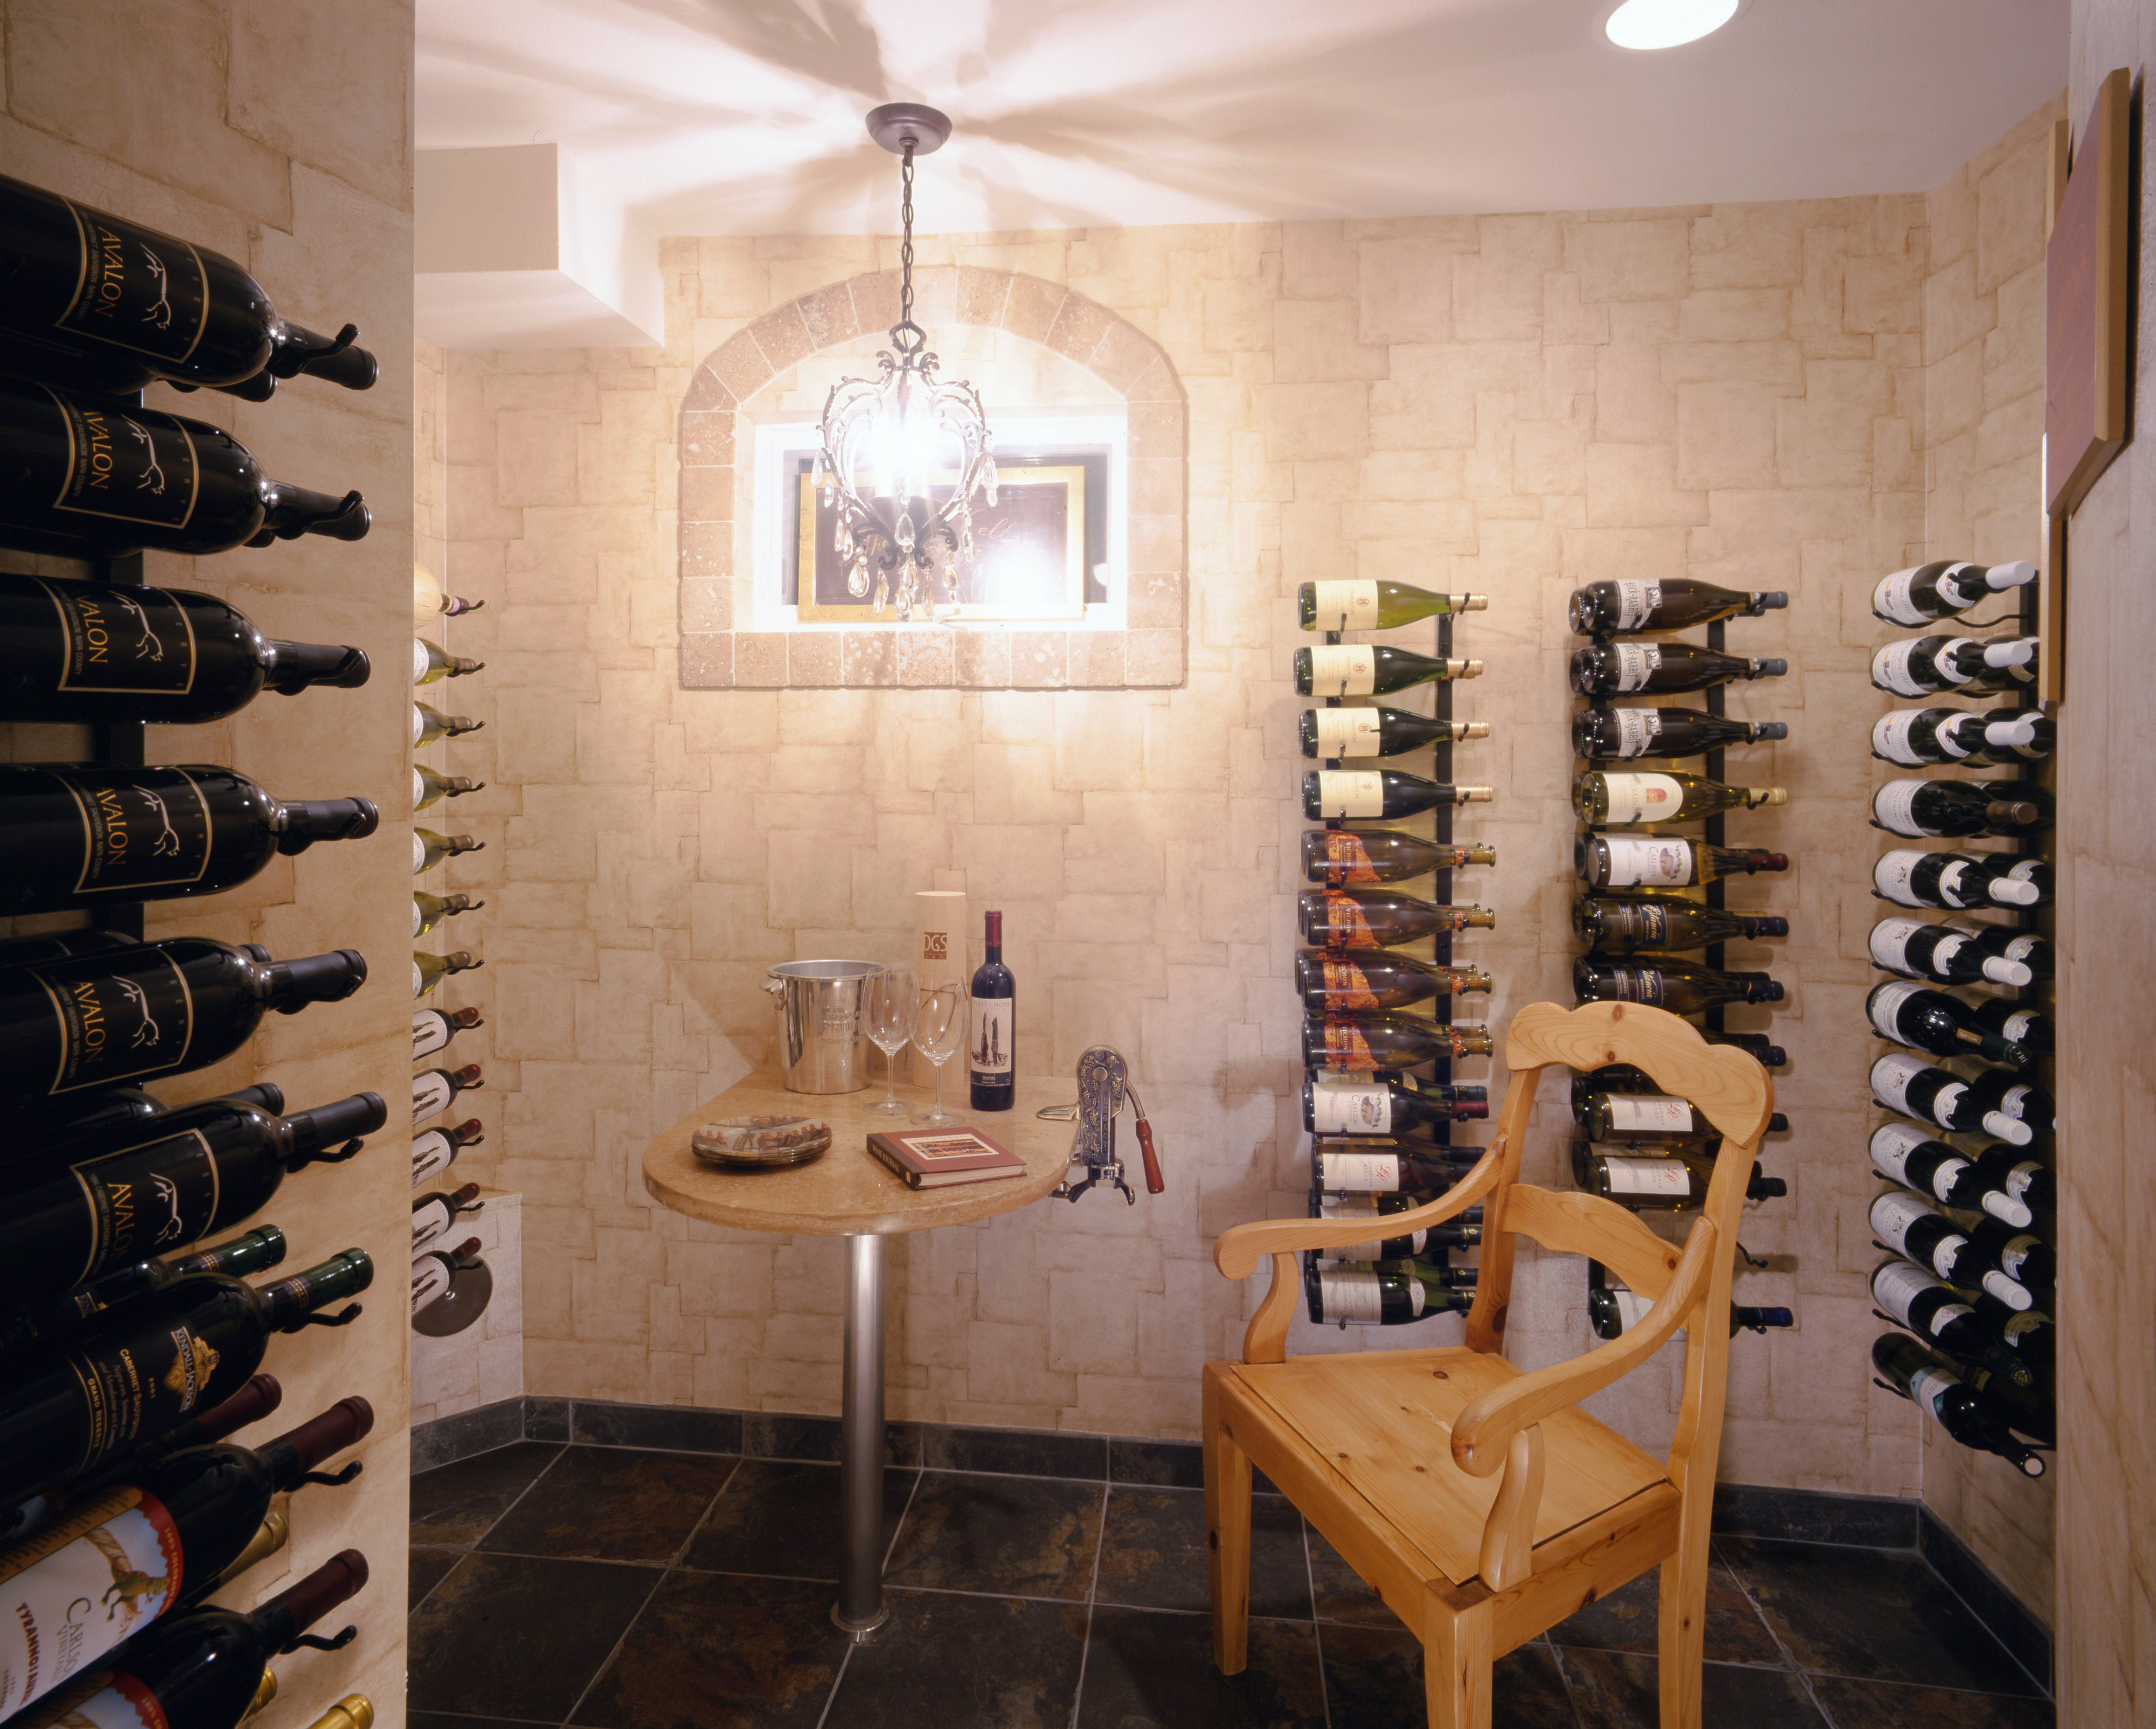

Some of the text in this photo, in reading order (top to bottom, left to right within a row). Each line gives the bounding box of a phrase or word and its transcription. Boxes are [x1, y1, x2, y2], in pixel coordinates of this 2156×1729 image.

[93, 225, 124, 318] AVALON
[79, 458, 88, 474] NAPA
[74, 635, 84, 650] NAPA
[75, 595, 109, 663] VALON
[96, 841, 104, 857] NAPA
[1649, 847, 1659, 876] CARLSON
[1642, 905, 1662, 940] Estancia
[68, 981, 107, 1063] AVALON
[1351, 1094, 1361, 1125] CARLSON
[120, 1348, 140, 1392] CABERNET
[174, 1328, 196, 1412] KENDALL-JACKSON
[88, 1378, 100, 1408] GRAND
[57, 1598, 91, 1682] CARLSO
